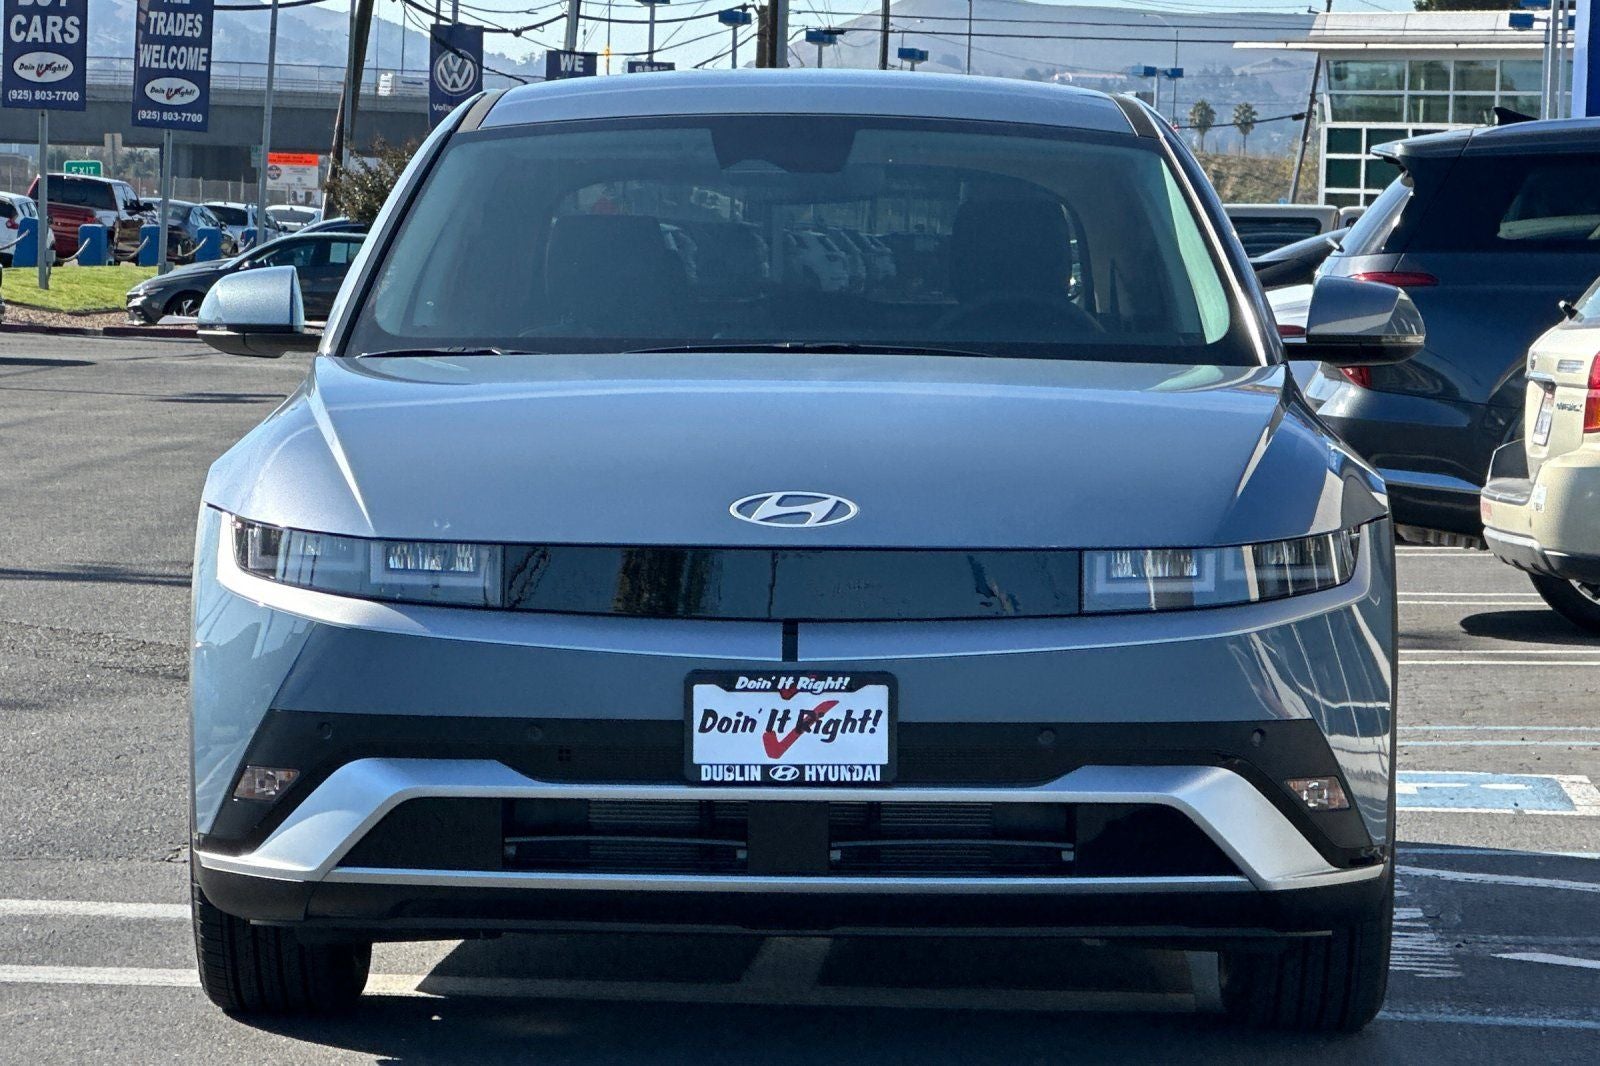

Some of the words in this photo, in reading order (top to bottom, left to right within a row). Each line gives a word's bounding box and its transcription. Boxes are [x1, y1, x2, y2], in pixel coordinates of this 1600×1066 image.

[10, 14, 79, 44] CARS
[148, 11, 203, 38] TRADES
[139, 43, 208, 71] WELCOME
[560, 53, 585, 72] WE
[8, 89, 32, 102] (925)
[34, 90, 79, 101] 803-7700
[137, 109, 160, 122] (925)
[162, 111, 203, 123] 803-7700
[71, 166, 95, 175] EXIT
[735, 676, 775, 690] Doin'
[777, 676, 796, 690] It
[797, 676, 850, 694] Right!
[698, 708, 763, 733] Doin'
[765, 708, 791, 733] It
[795, 708, 883, 743] Right!
[700, 765, 762, 782] DUBLIN
[804, 765, 881, 782] HYUNDAI
